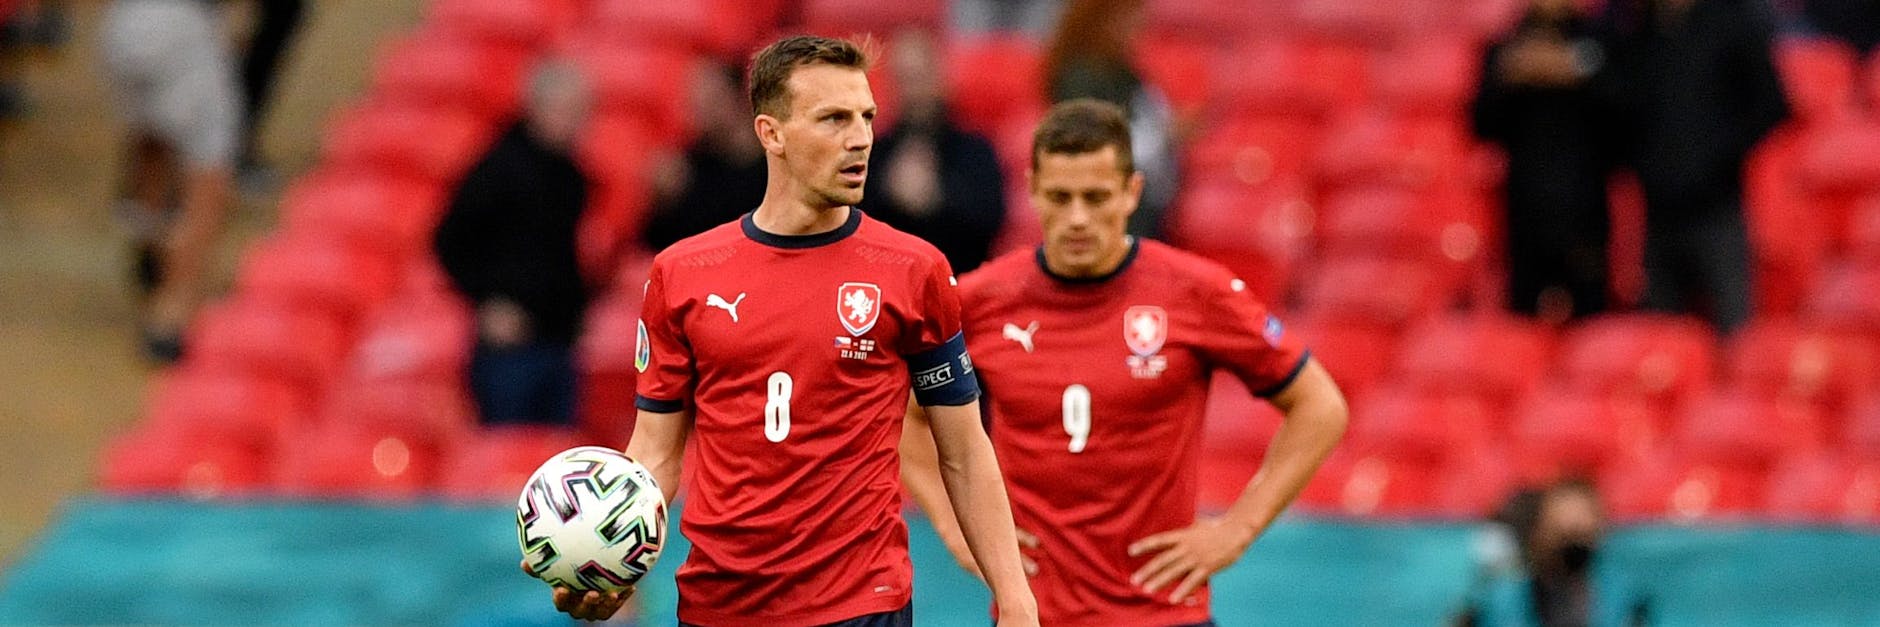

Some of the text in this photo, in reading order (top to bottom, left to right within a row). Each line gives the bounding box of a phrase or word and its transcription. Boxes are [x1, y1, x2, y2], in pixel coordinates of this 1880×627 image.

[764, 371, 793, 443] 8
[914, 366, 951, 387] SPECT
[1062, 383, 1092, 453] 9
